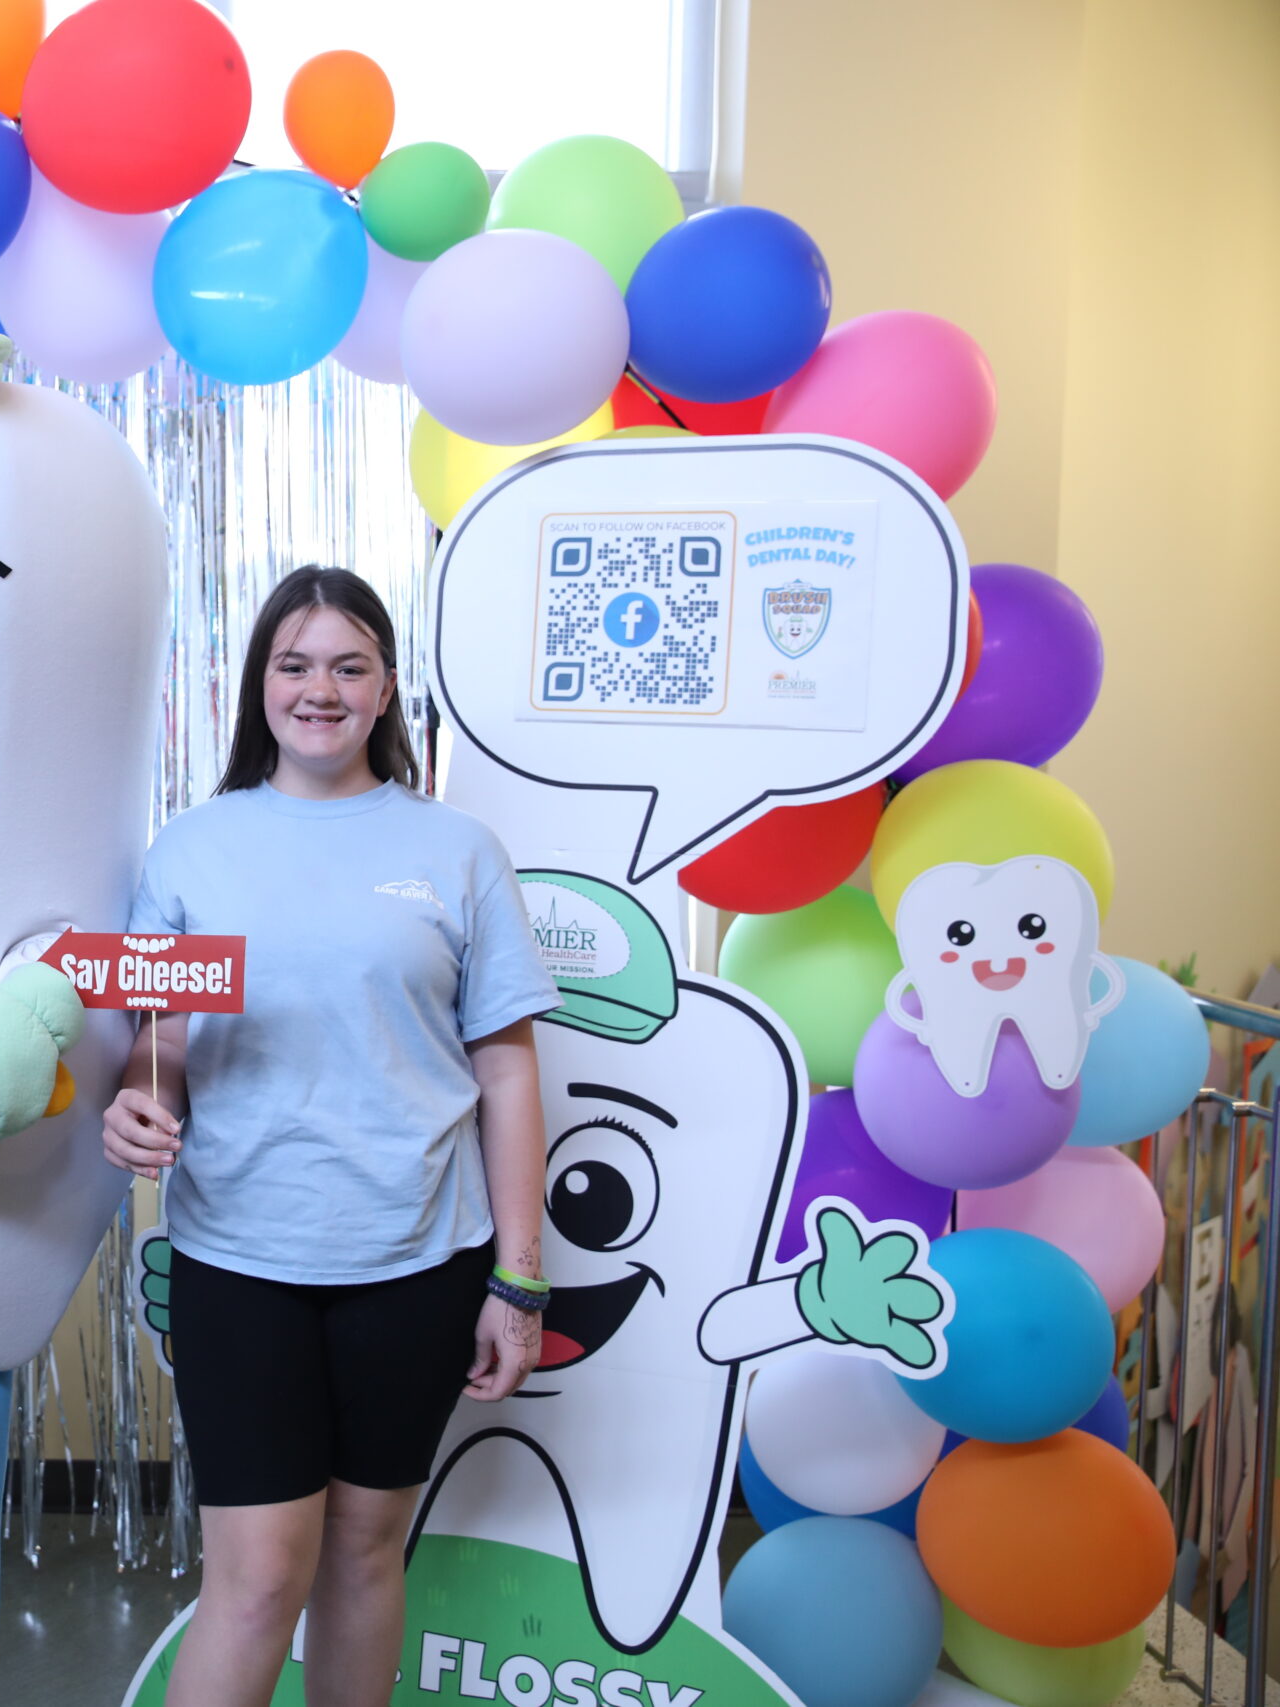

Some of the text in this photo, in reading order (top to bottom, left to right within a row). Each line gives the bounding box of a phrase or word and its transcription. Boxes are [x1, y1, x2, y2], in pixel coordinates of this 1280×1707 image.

[550, 521, 726, 532] SCAN TO FOLLOW ON FACEBOOK
[745, 526, 855, 546] CHILDREN'S
[747, 547, 856, 569] DENTAL DAY!
[533, 928, 596, 951] MIER
[541, 949, 597, 960] HealthCare
[60, 953, 233, 995] Say Cheese!
